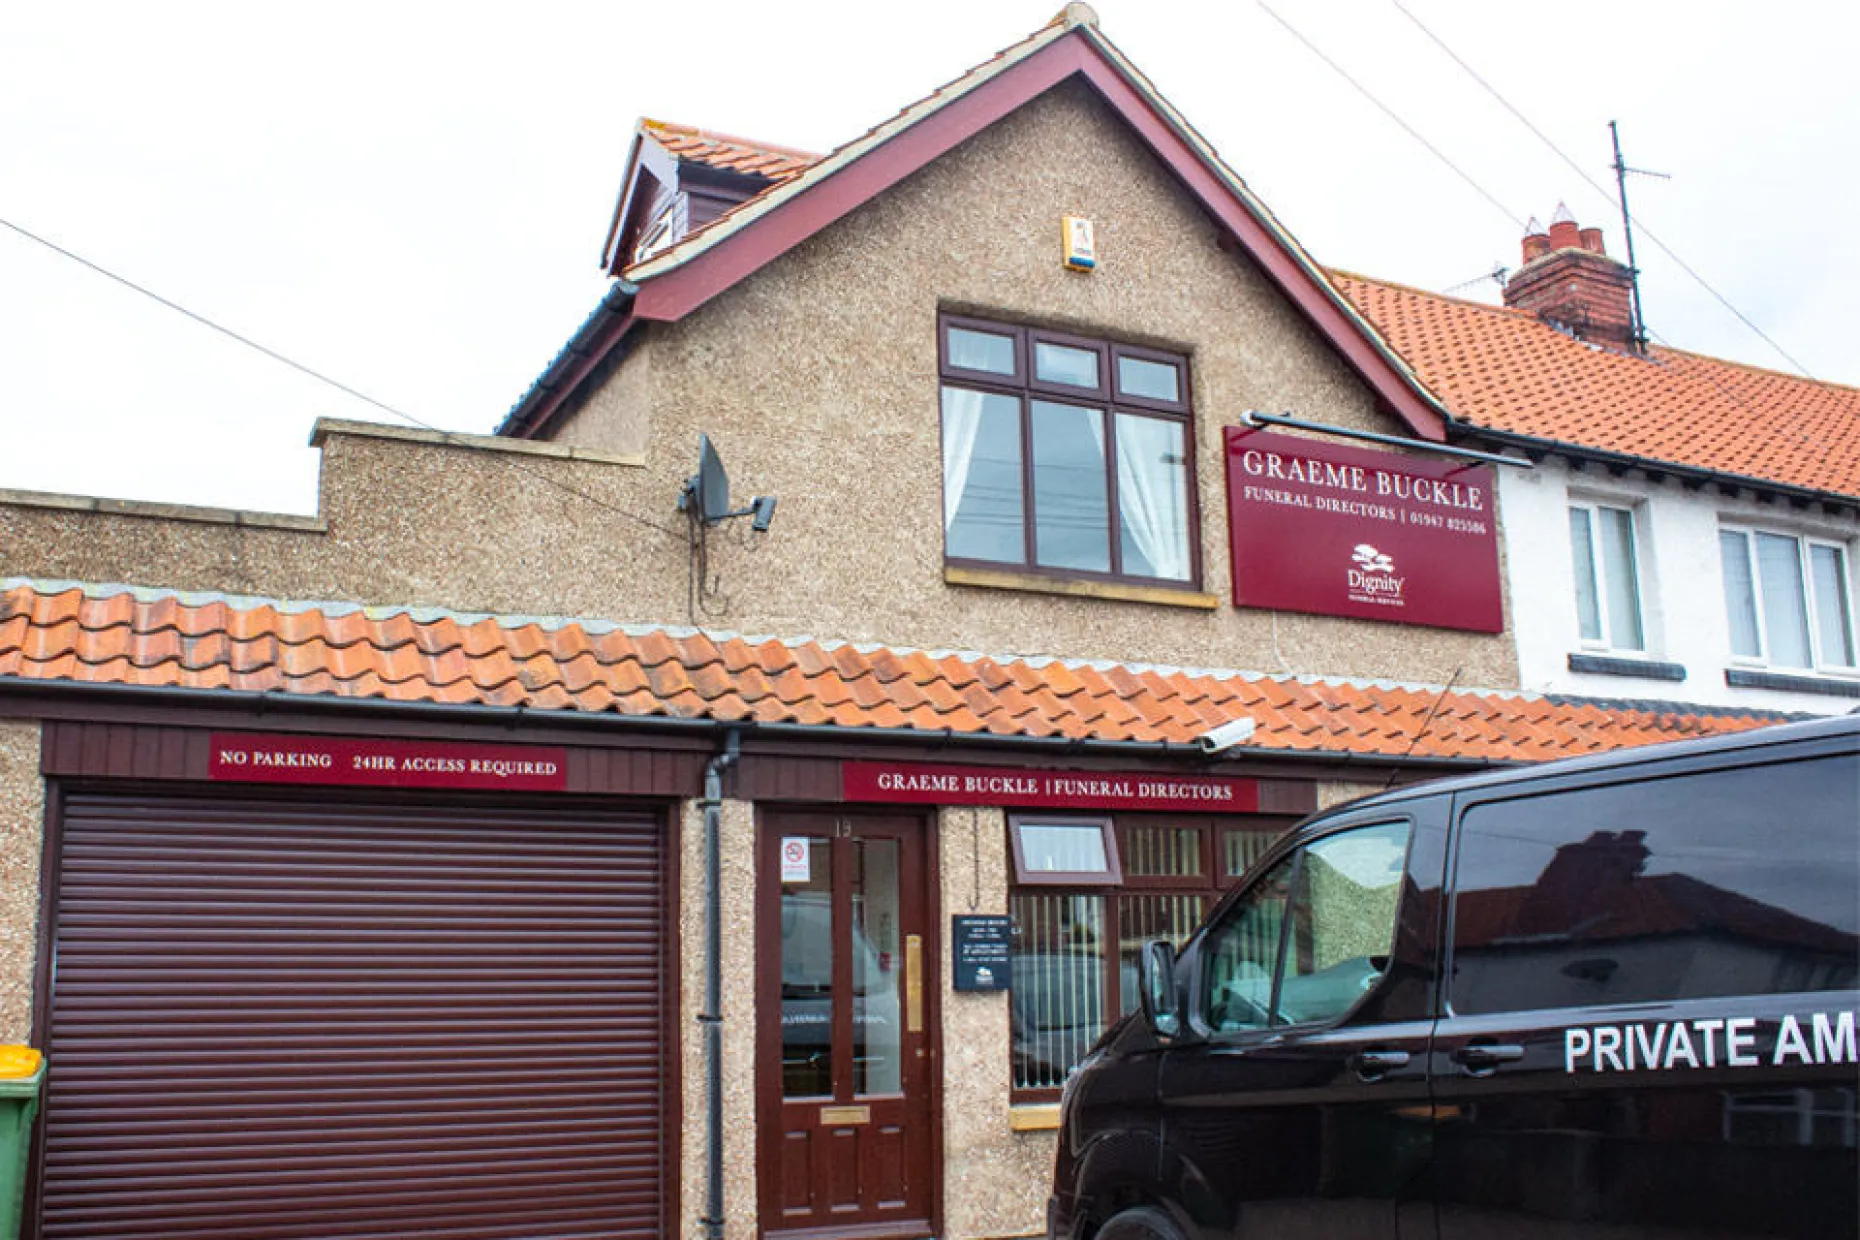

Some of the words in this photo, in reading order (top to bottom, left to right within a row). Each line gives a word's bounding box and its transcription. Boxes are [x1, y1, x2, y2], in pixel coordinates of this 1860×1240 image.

[1243, 450, 1367, 492] GRAEME
[1376, 471, 1483, 511] BUCKLE
[1244, 486, 1313, 508] FUNERAL
[1316, 496, 1396, 521] DIRECTORS
[1347, 569, 1406, 598] Dignity
[220, 750, 248, 765] NO
[253, 751, 332, 768] PARKING
[353, 755, 396, 770] 24HR
[402, 757, 466, 773] ACCESS
[470, 759, 557, 778] REQUIRED
[878, 773, 960, 792] GRAEME
[965, 776, 1039, 794] BUCKLE
[1054, 779, 1134, 797] FUNERAL
[1138, 782, 1233, 800] DIRECTORS
[1565, 1016, 1760, 1074] PRIVATE
[1771, 1010, 1859, 1066] AM
